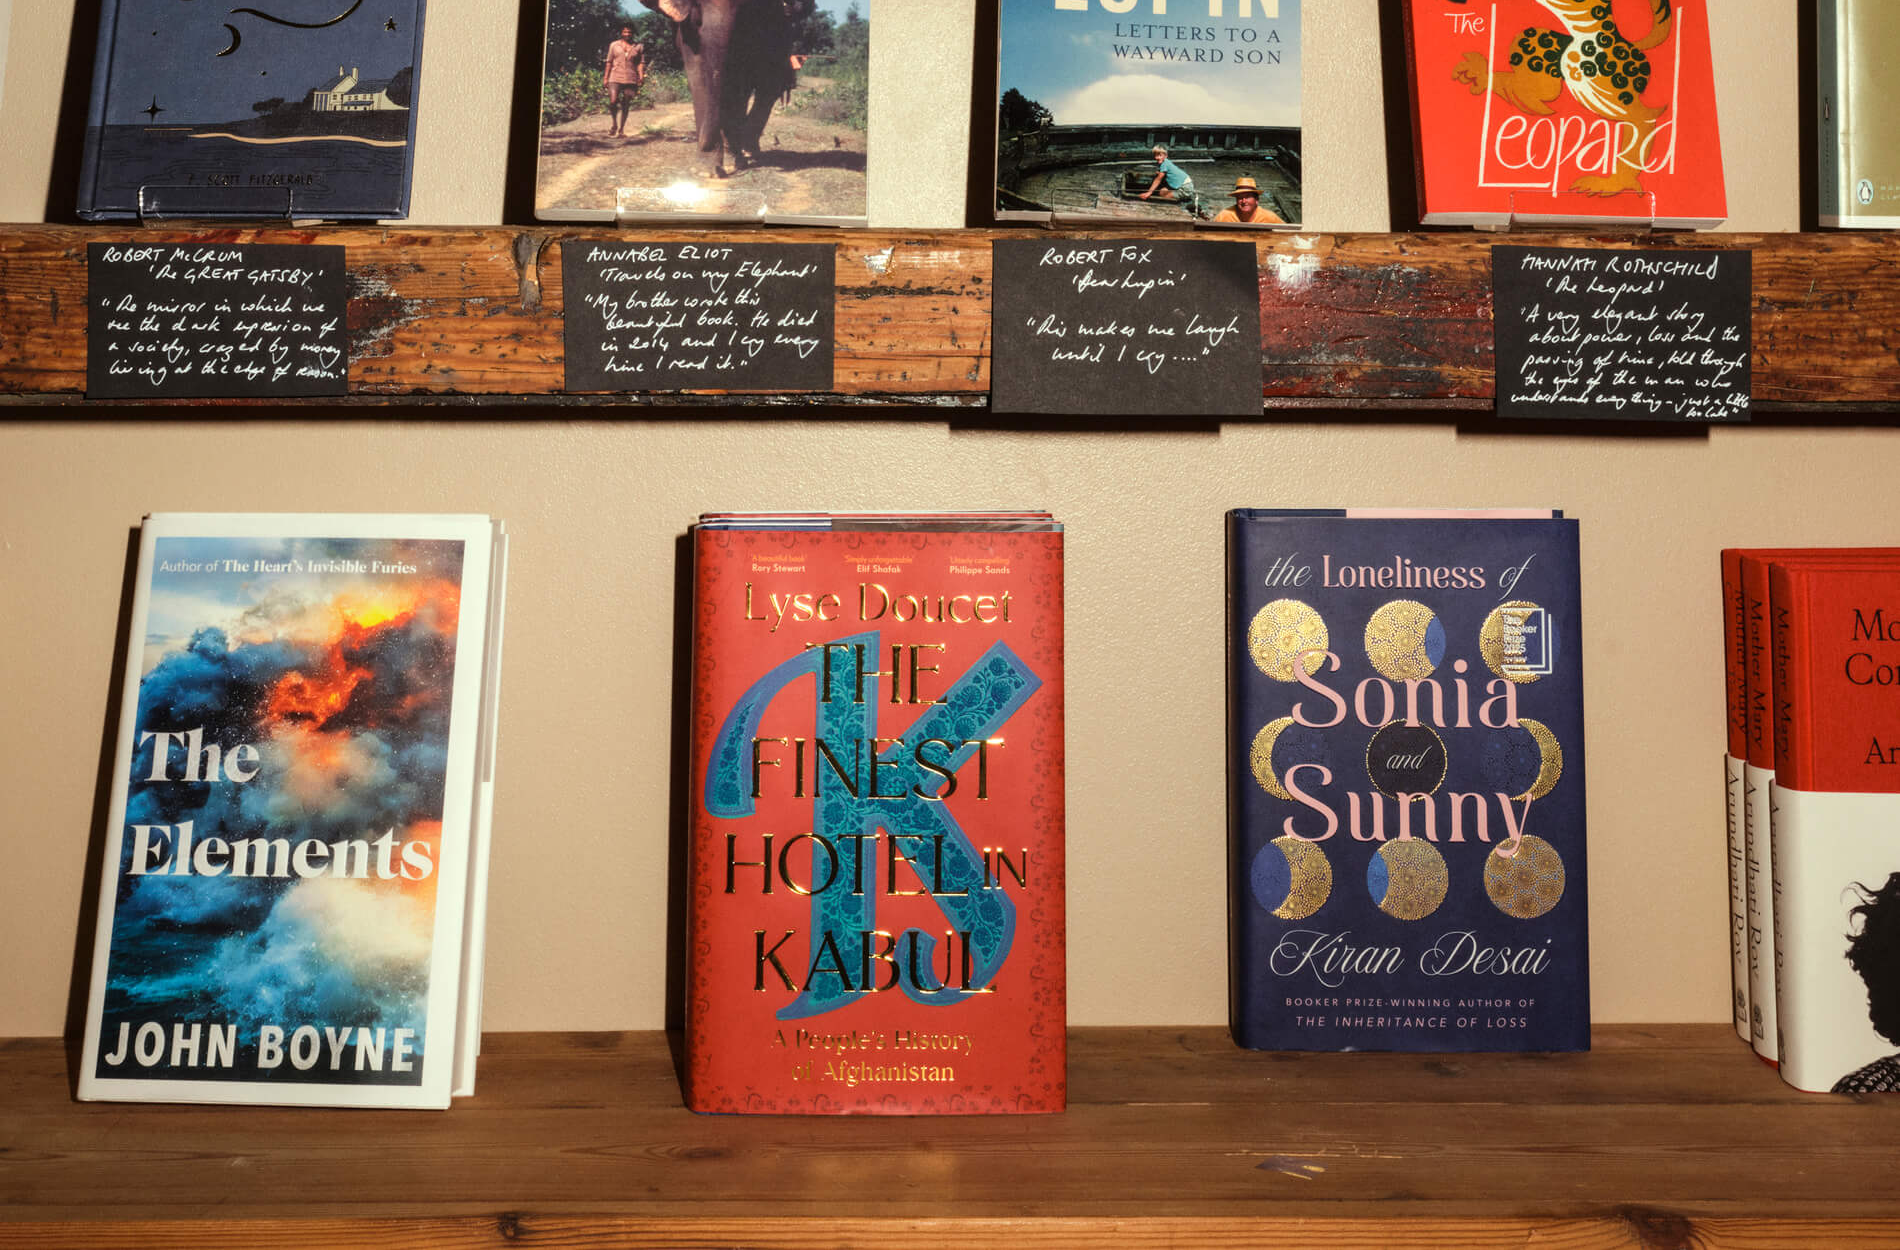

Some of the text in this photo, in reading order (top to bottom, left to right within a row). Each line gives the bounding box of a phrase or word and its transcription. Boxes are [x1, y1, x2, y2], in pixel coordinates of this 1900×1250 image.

[1115, 23, 1281, 43] LETTERS TO A
[1444, 12, 1485, 34] The
[1113, 44, 1281, 65] WAYWARD SON
[102, 247, 242, 263] ROBERT McCRUM
[586, 245, 732, 263] ANNABEL ELIOT
[1039, 247, 1114, 266] ROBERT
[1521, 254, 1598, 271] HANNAH
[184, 266, 245, 284] GREAT
[672, 269, 729, 293] on my
[147, 294, 325, 312] mirror in which we
[626, 288, 760, 309] brother wrote this
[140, 314, 338, 339] the dark of
[606, 309, 818, 338] beautiful book. He died
[1078, 314, 1239, 346] makes me laugh
[1548, 302, 1704, 334] very elegant story
[601, 330, 819, 359] in 2014 and I cry every
[1529, 325, 1740, 344] about loss and the
[269, 337, 288, 364] by
[668, 355, 706, 371] read
[1051, 343, 1103, 362] until
[1593, 350, 1614, 373] of
[1701, 349, 1746, 375] through
[109, 360, 166, 385] living
[174, 361, 192, 374] at
[272, 362, 292, 382] of
[1524, 370, 1731, 393] the eyes of the man who
[160, 560, 417, 574] Author of The Heart's Invisible Furies
[751, 563, 806, 573] Rory Stewart
[857, 564, 901, 573] Elif Shafak
[949, 565, 1010, 576] Philippe Sands
[1264, 552, 1536, 600] the Loneliness of
[744, 582, 1013, 633] Lyse Doucet
[805, 642, 948, 705] THE
[1749, 597, 1767, 751] Mother Mary
[1776, 606, 1793, 763] Mother Mary
[1292, 650, 1522, 728] Sonia
[139, 728, 260, 784] The
[1386, 746, 1433, 771] and
[750, 737, 1005, 801] FINEST
[1283, 764, 1533, 858] Sunny
[126, 820, 438, 880] Elements
[724, 832, 1028, 896] HOTEL IN
[1728, 768, 1746, 967] Arundhati Roy
[1745, 781, 1762, 982] Arundhati Roy
[753, 930, 998, 994] KABUL
[1270, 929, 1552, 988] Kiran Desai
[1286, 997, 1537, 1008] BOOKER PRIZE-WINNING AUTHOR OF
[1296, 1016, 1528, 1029] THE INHERITANCE OF LOSS
[104, 1022, 415, 1072] JOHN BOYNE
[771, 1029, 973, 1056] A People's History
[792, 1060, 955, 1087] of Afghanistan
